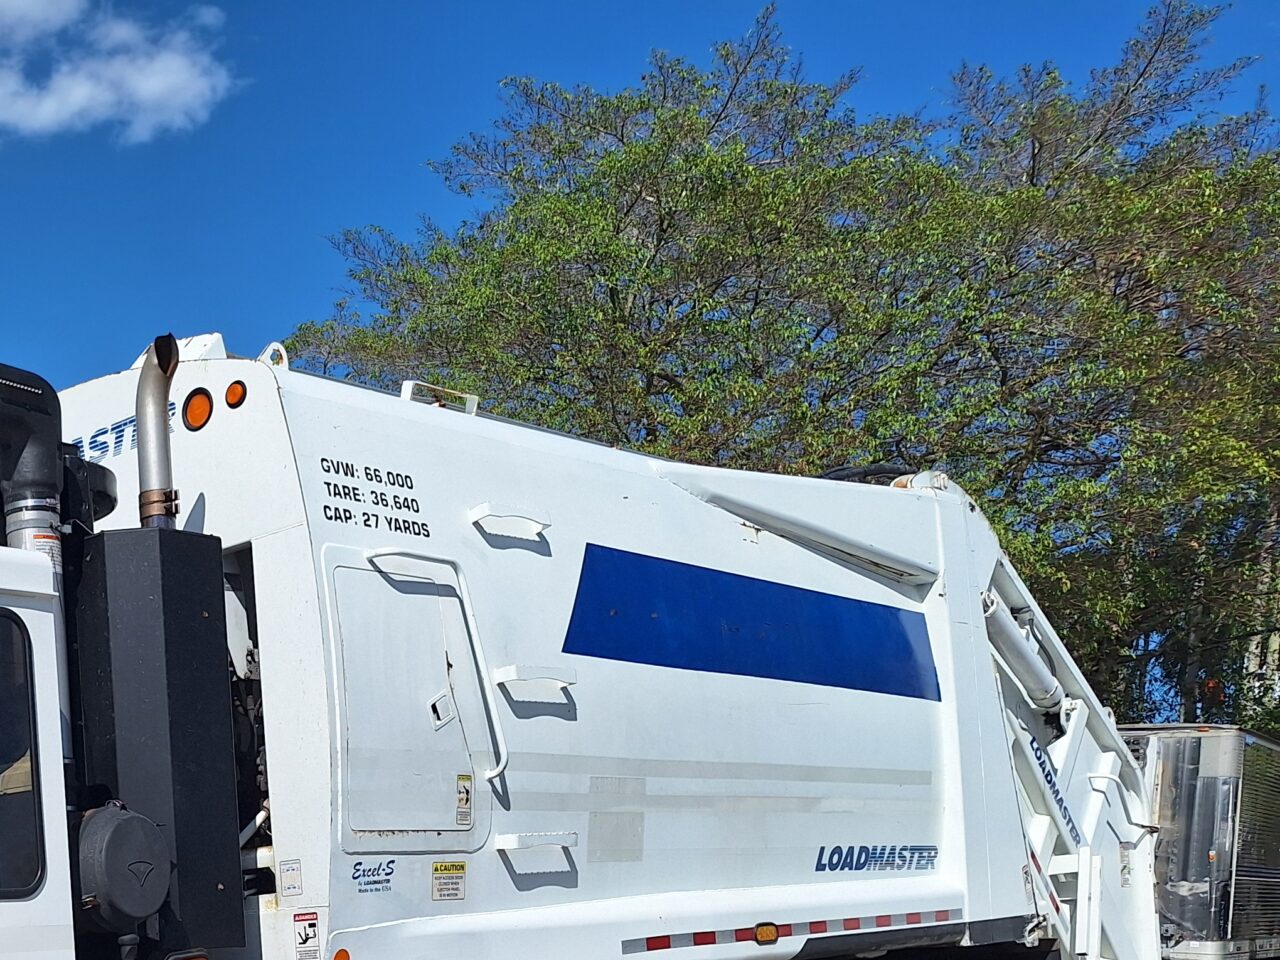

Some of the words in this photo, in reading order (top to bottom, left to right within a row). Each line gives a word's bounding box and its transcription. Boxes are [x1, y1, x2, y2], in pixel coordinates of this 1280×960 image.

[320, 457, 360, 479] GVW:
[364, 467, 414, 490] 66,000
[323, 481, 366, 504] TARE:
[370, 491, 420, 513] 36,640
[323, 505, 358, 526] CAP:
[362, 513, 380, 529] 27
[384, 516, 430, 538] YARDS
[1029, 736, 1082, 849] LOADMASTER
[352, 859, 396, 880] Excel-S
[440, 863, 465, 872] CAUTION
[815, 845, 938, 872] LOADMASTER
